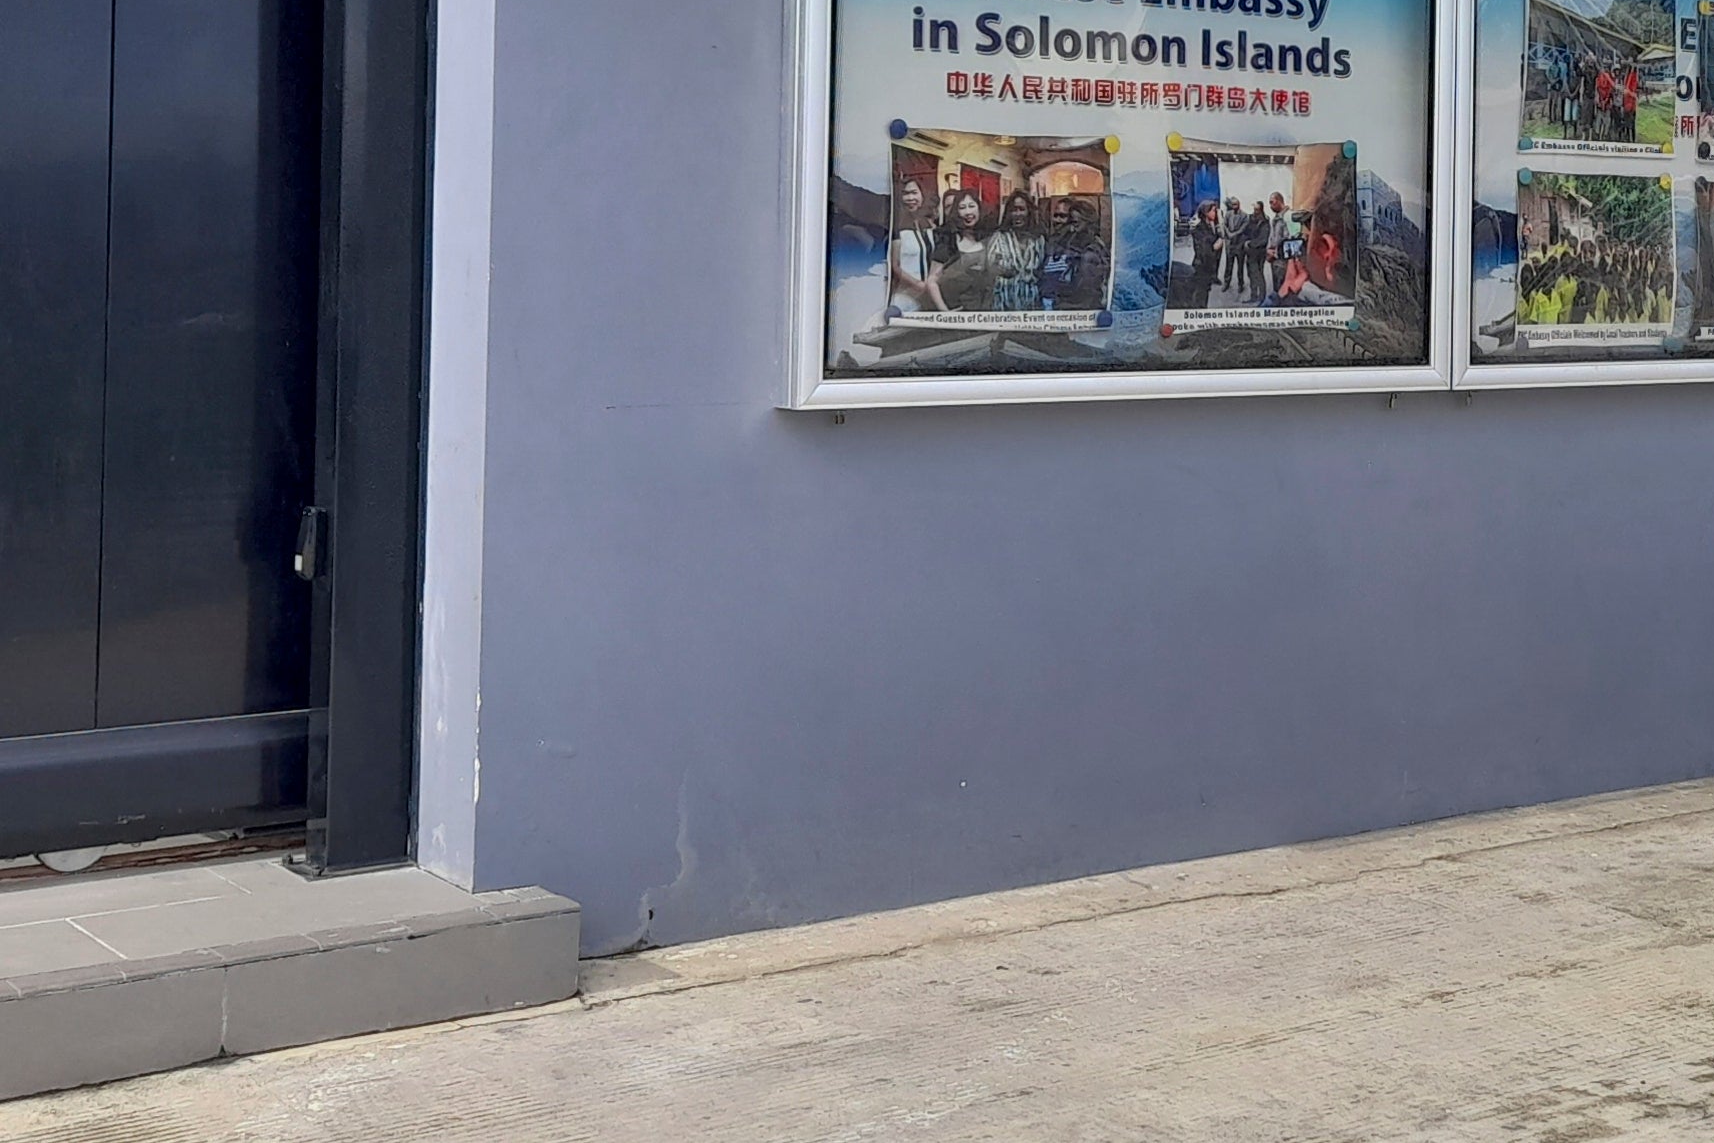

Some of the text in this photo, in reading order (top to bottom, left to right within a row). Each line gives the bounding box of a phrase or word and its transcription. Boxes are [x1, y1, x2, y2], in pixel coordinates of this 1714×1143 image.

[912, 6, 1352, 78] in Solomon Islands
[945, 69, 1312, 117] 中华人民共和国驻所罗门群岛大使馆
[936, 313, 966, 324] Guests
[967, 314, 976, 323] of
[977, 313, 1022, 323] Celebration
[1023, 313, 1046, 323] Event
[1183, 308, 1335, 319] Solomon Islands Media Delegation
[1172, 322, 1195, 331] poke
